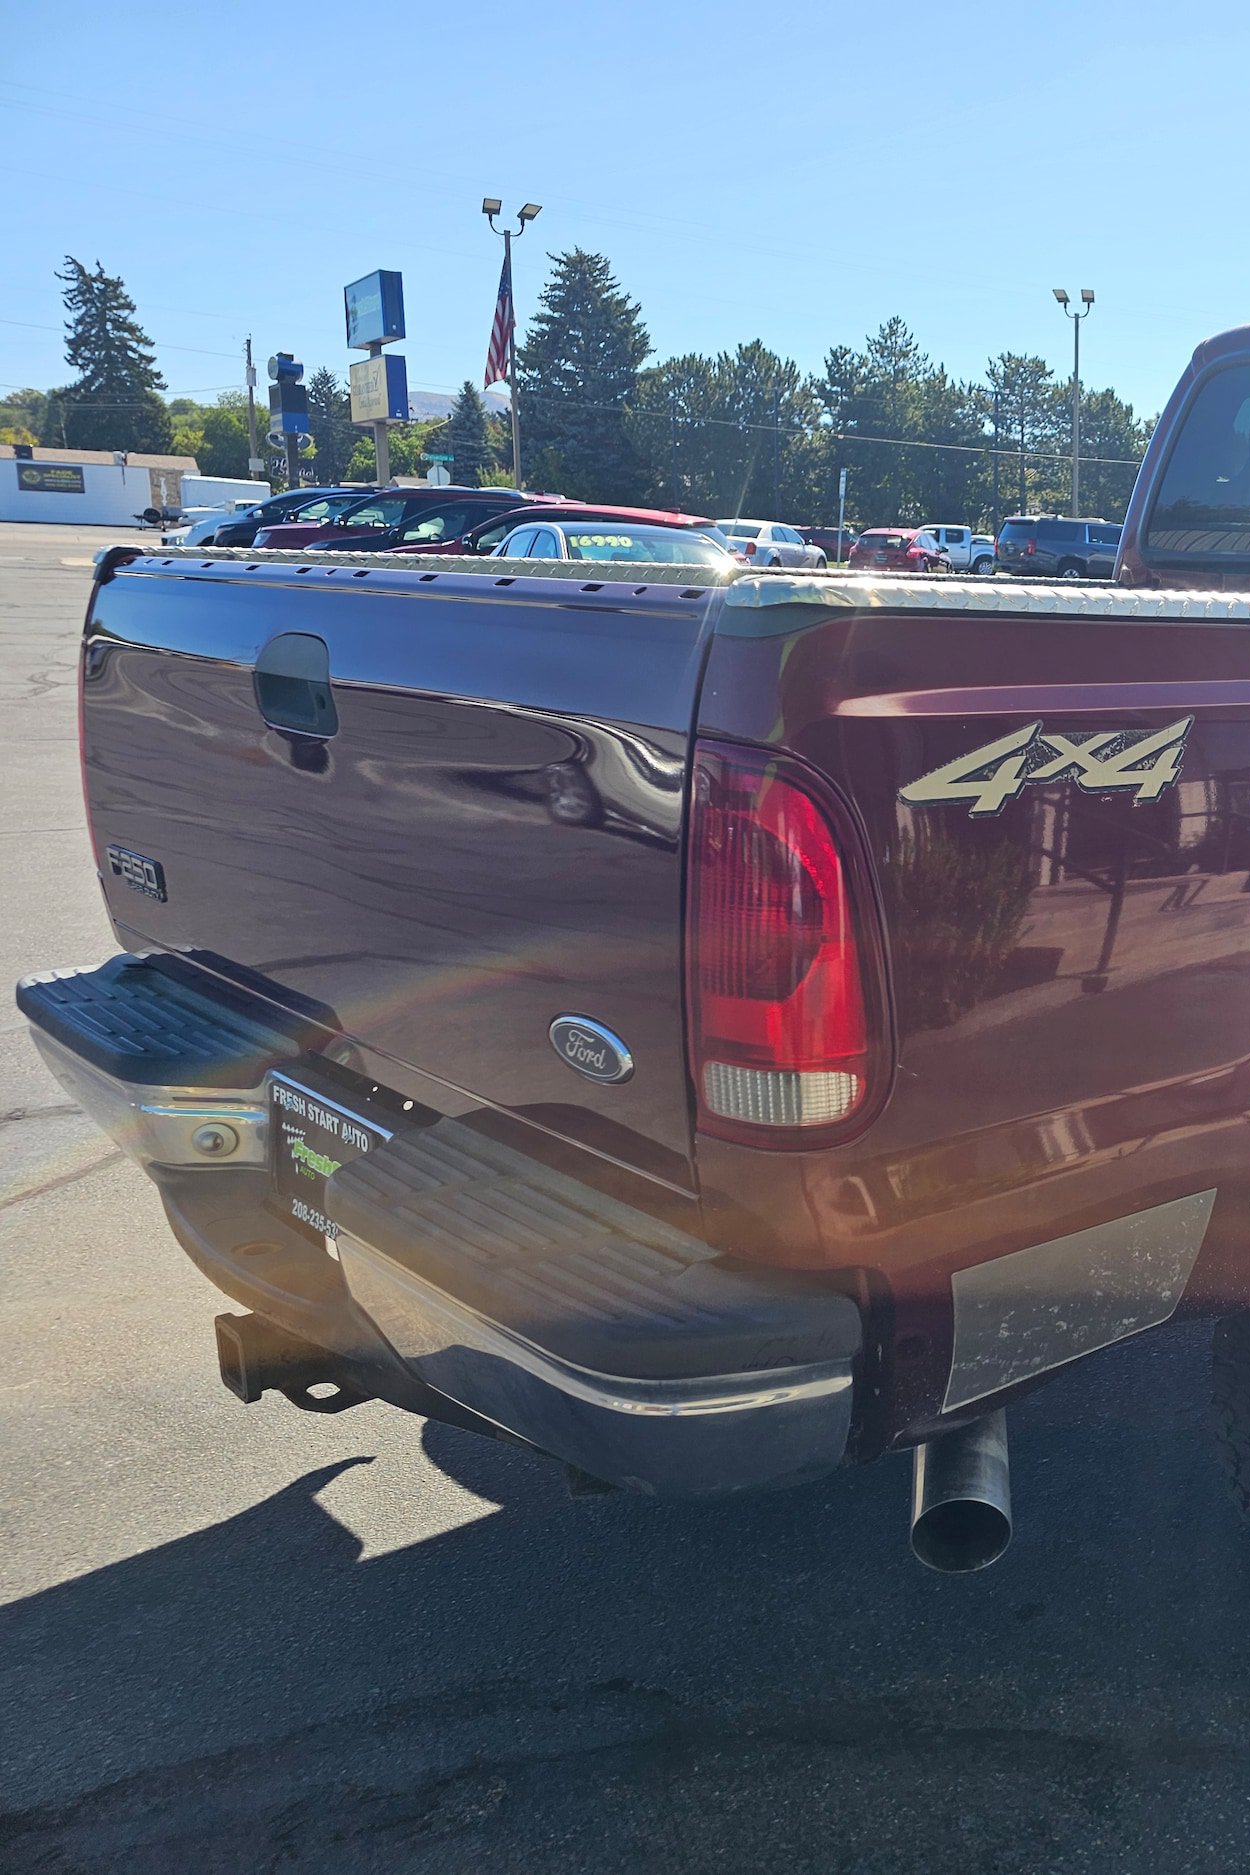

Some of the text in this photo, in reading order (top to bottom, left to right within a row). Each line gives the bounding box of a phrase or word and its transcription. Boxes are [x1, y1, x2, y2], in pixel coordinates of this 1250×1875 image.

[568, 535, 634, 548] 16990
[565, 1029, 607, 1070] Ford
[273, 1085, 369, 1153] FRESH START AUTO
